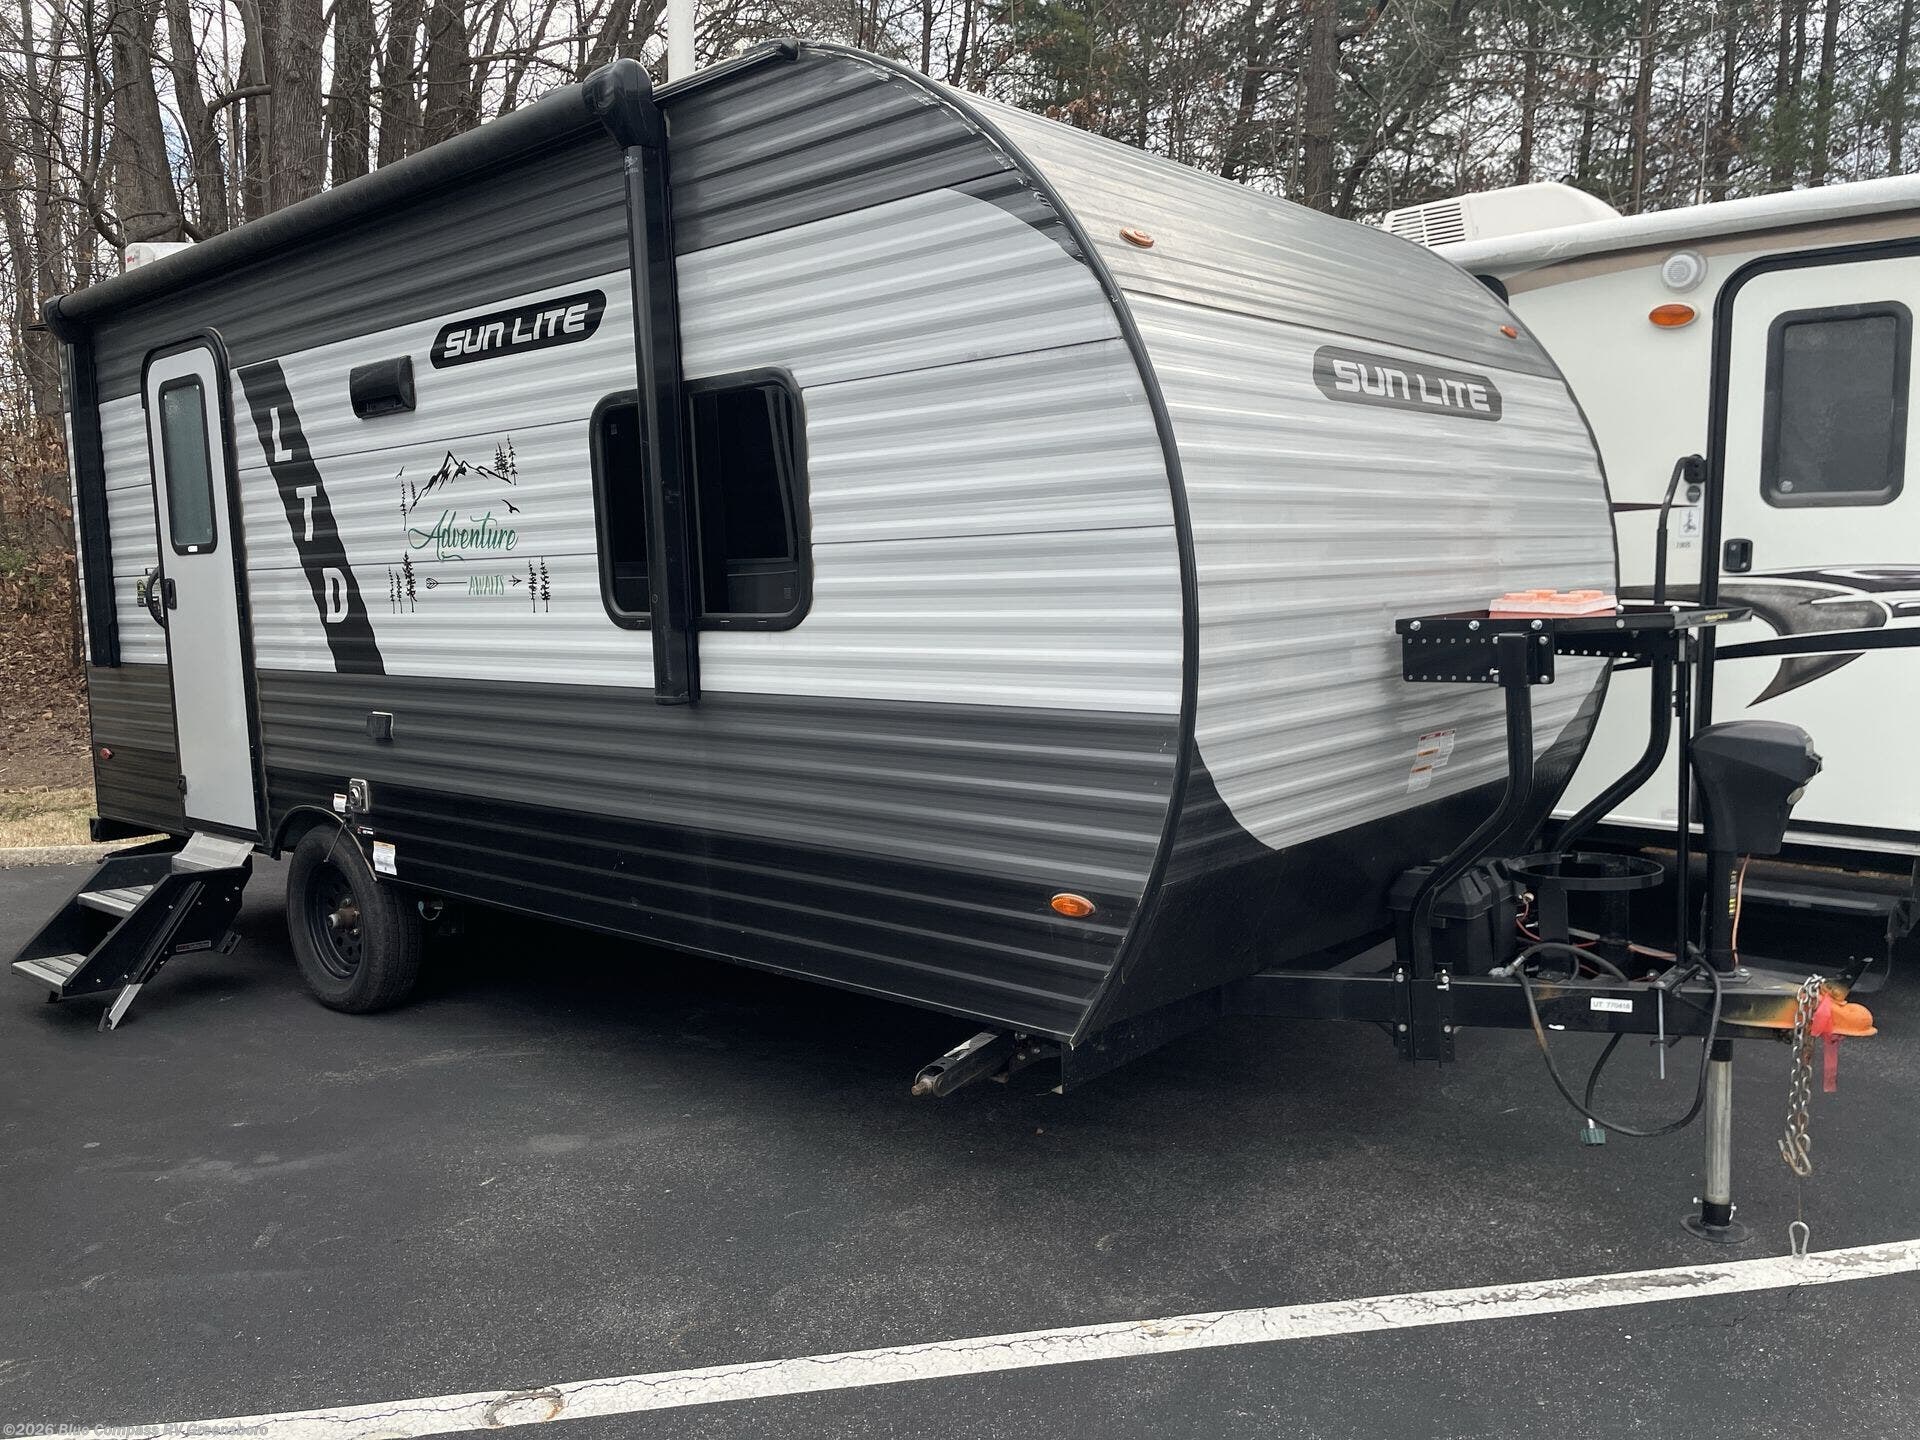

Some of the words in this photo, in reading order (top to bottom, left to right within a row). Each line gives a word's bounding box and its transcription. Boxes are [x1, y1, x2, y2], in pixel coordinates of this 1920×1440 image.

[443, 321, 505, 359] SUN
[511, 302, 589, 345] LITE
[1332, 359, 1411, 401] SUN
[1416, 373, 1491, 412] LITE
[407, 509, 519, 562] Adventure
[468, 574, 505, 596] AWAITS
